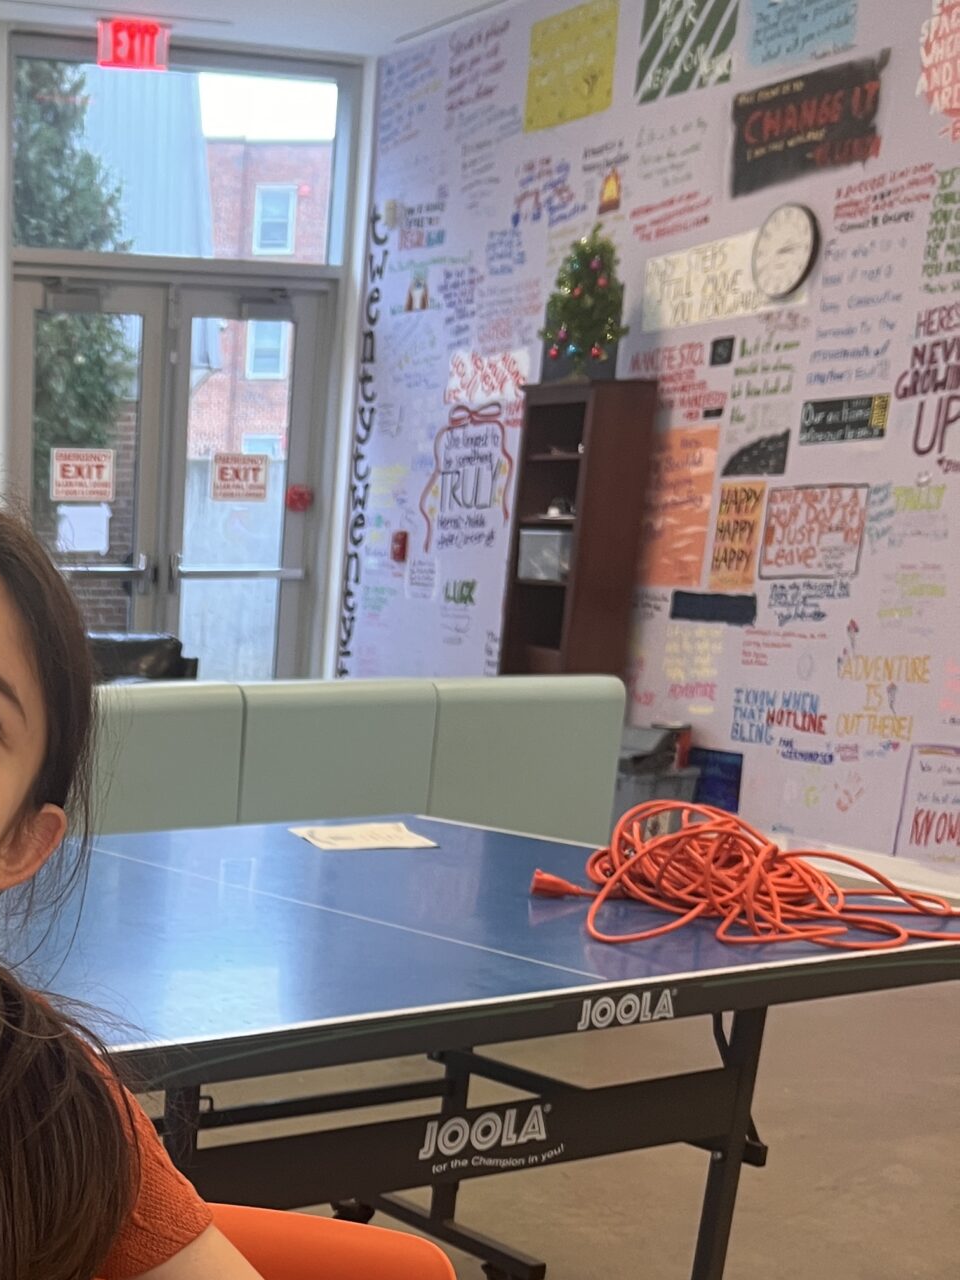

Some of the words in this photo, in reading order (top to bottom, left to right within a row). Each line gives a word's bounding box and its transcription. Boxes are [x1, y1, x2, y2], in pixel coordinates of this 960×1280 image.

[111, 20, 159, 65] EXIT
[60, 464, 104, 480] EXIT
[220, 467, 261, 482] EXIT
[441, 460, 502, 511] TRULY
[721, 486, 762, 514] HAPPY
[716, 520, 756, 545] HAPPY
[713, 549, 752, 571] HAPPY
[839, 655, 931, 684] ADVENTURE
[744, 689, 777, 708] KNOW
[782, 690, 820, 713] WHEN
[863, 683, 883, 712] IS
[730, 722, 775, 745] BLING
[733, 705, 765, 721] THAT
[766, 707, 828, 735] HOTLINE
[836, 713, 865, 737] OUT
[865, 713, 913, 742] THERE!
[577, 989, 674, 1031] JOOLA
[418, 1104, 546, 1160] JOOLA
[432, 1161, 448, 1174] for
[450, 1157, 468, 1168] the
[471, 1155, 525, 1168] Champion
[528, 1152, 538, 1163] in
[541, 1143, 564, 1162] you!
